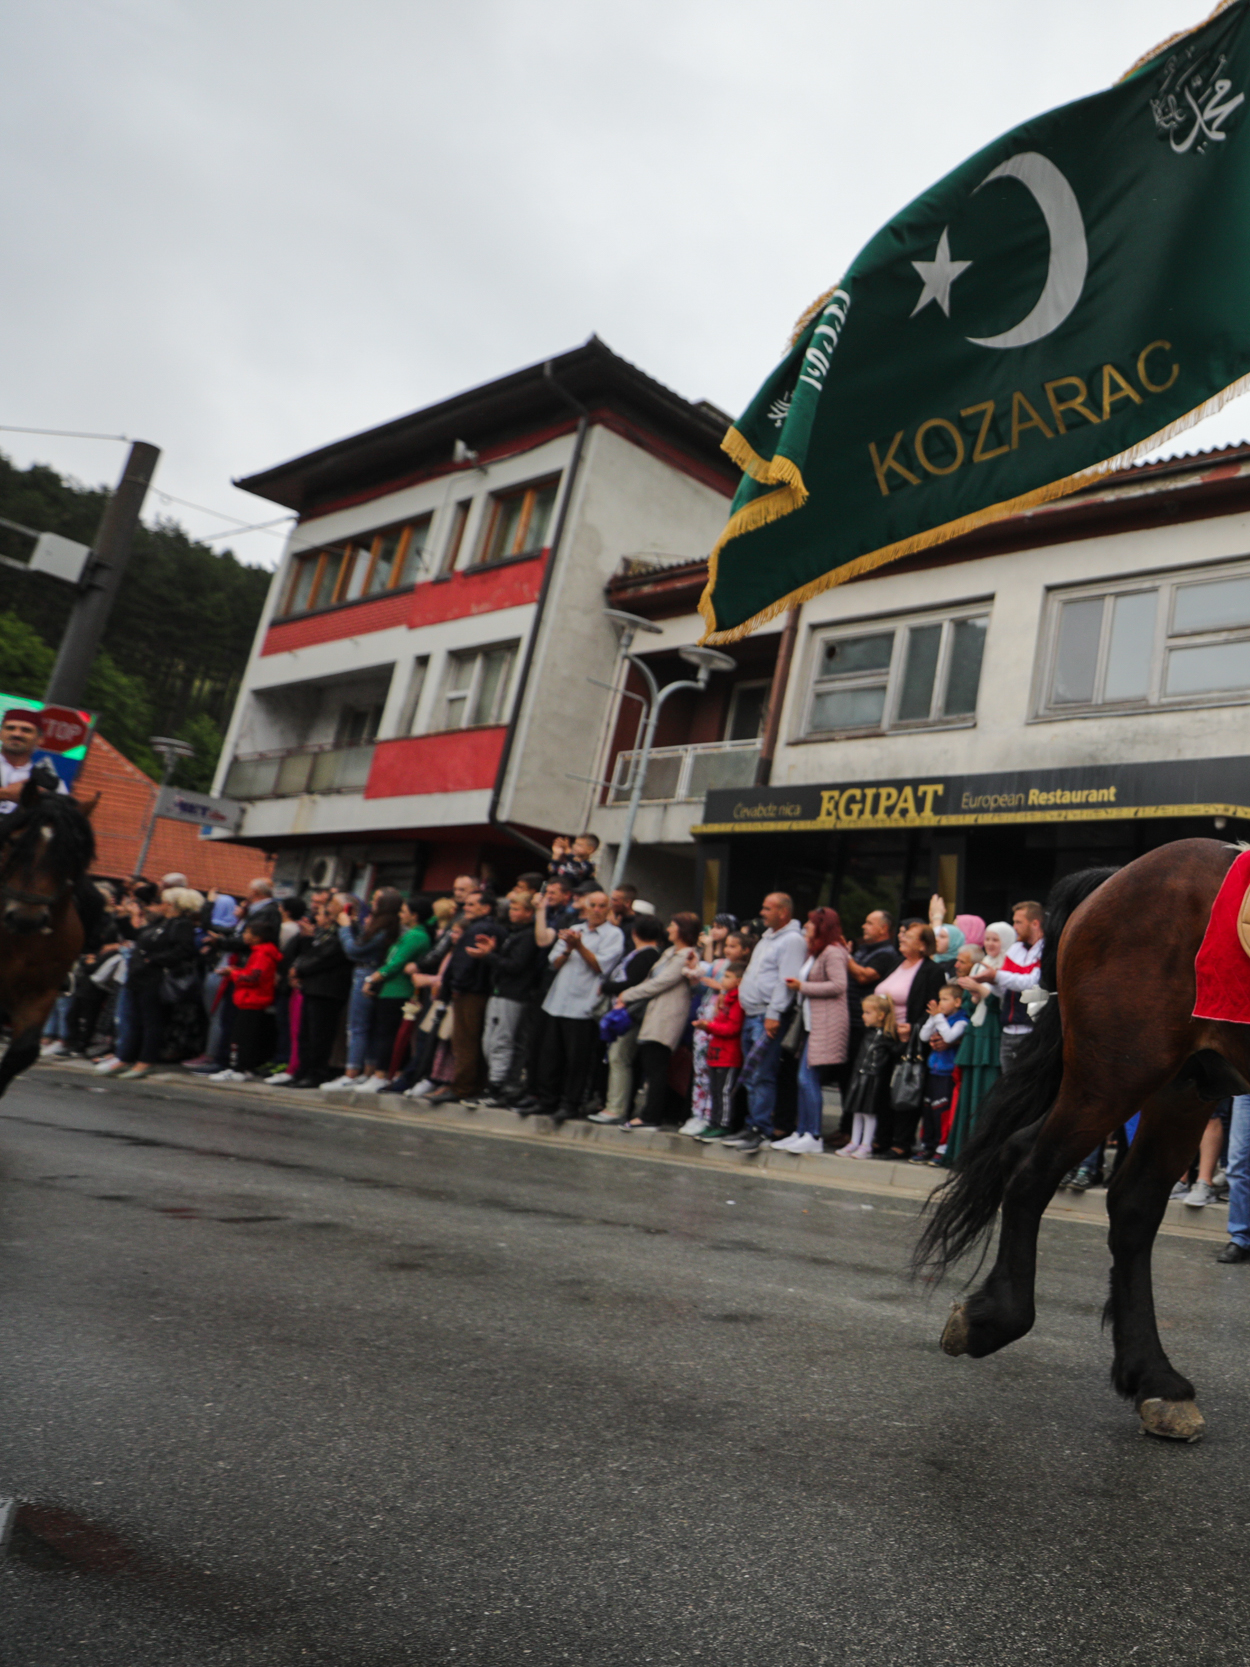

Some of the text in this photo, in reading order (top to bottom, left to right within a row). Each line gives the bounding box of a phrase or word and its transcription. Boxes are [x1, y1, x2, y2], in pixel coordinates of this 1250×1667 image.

[868, 339, 1181, 496] KOZARAC
[41, 717, 82, 742] TOP
[816, 784, 944, 820] EGIPAT
[961, 792, 1025, 811] European
[1028, 785, 1117, 806] Restaurant
